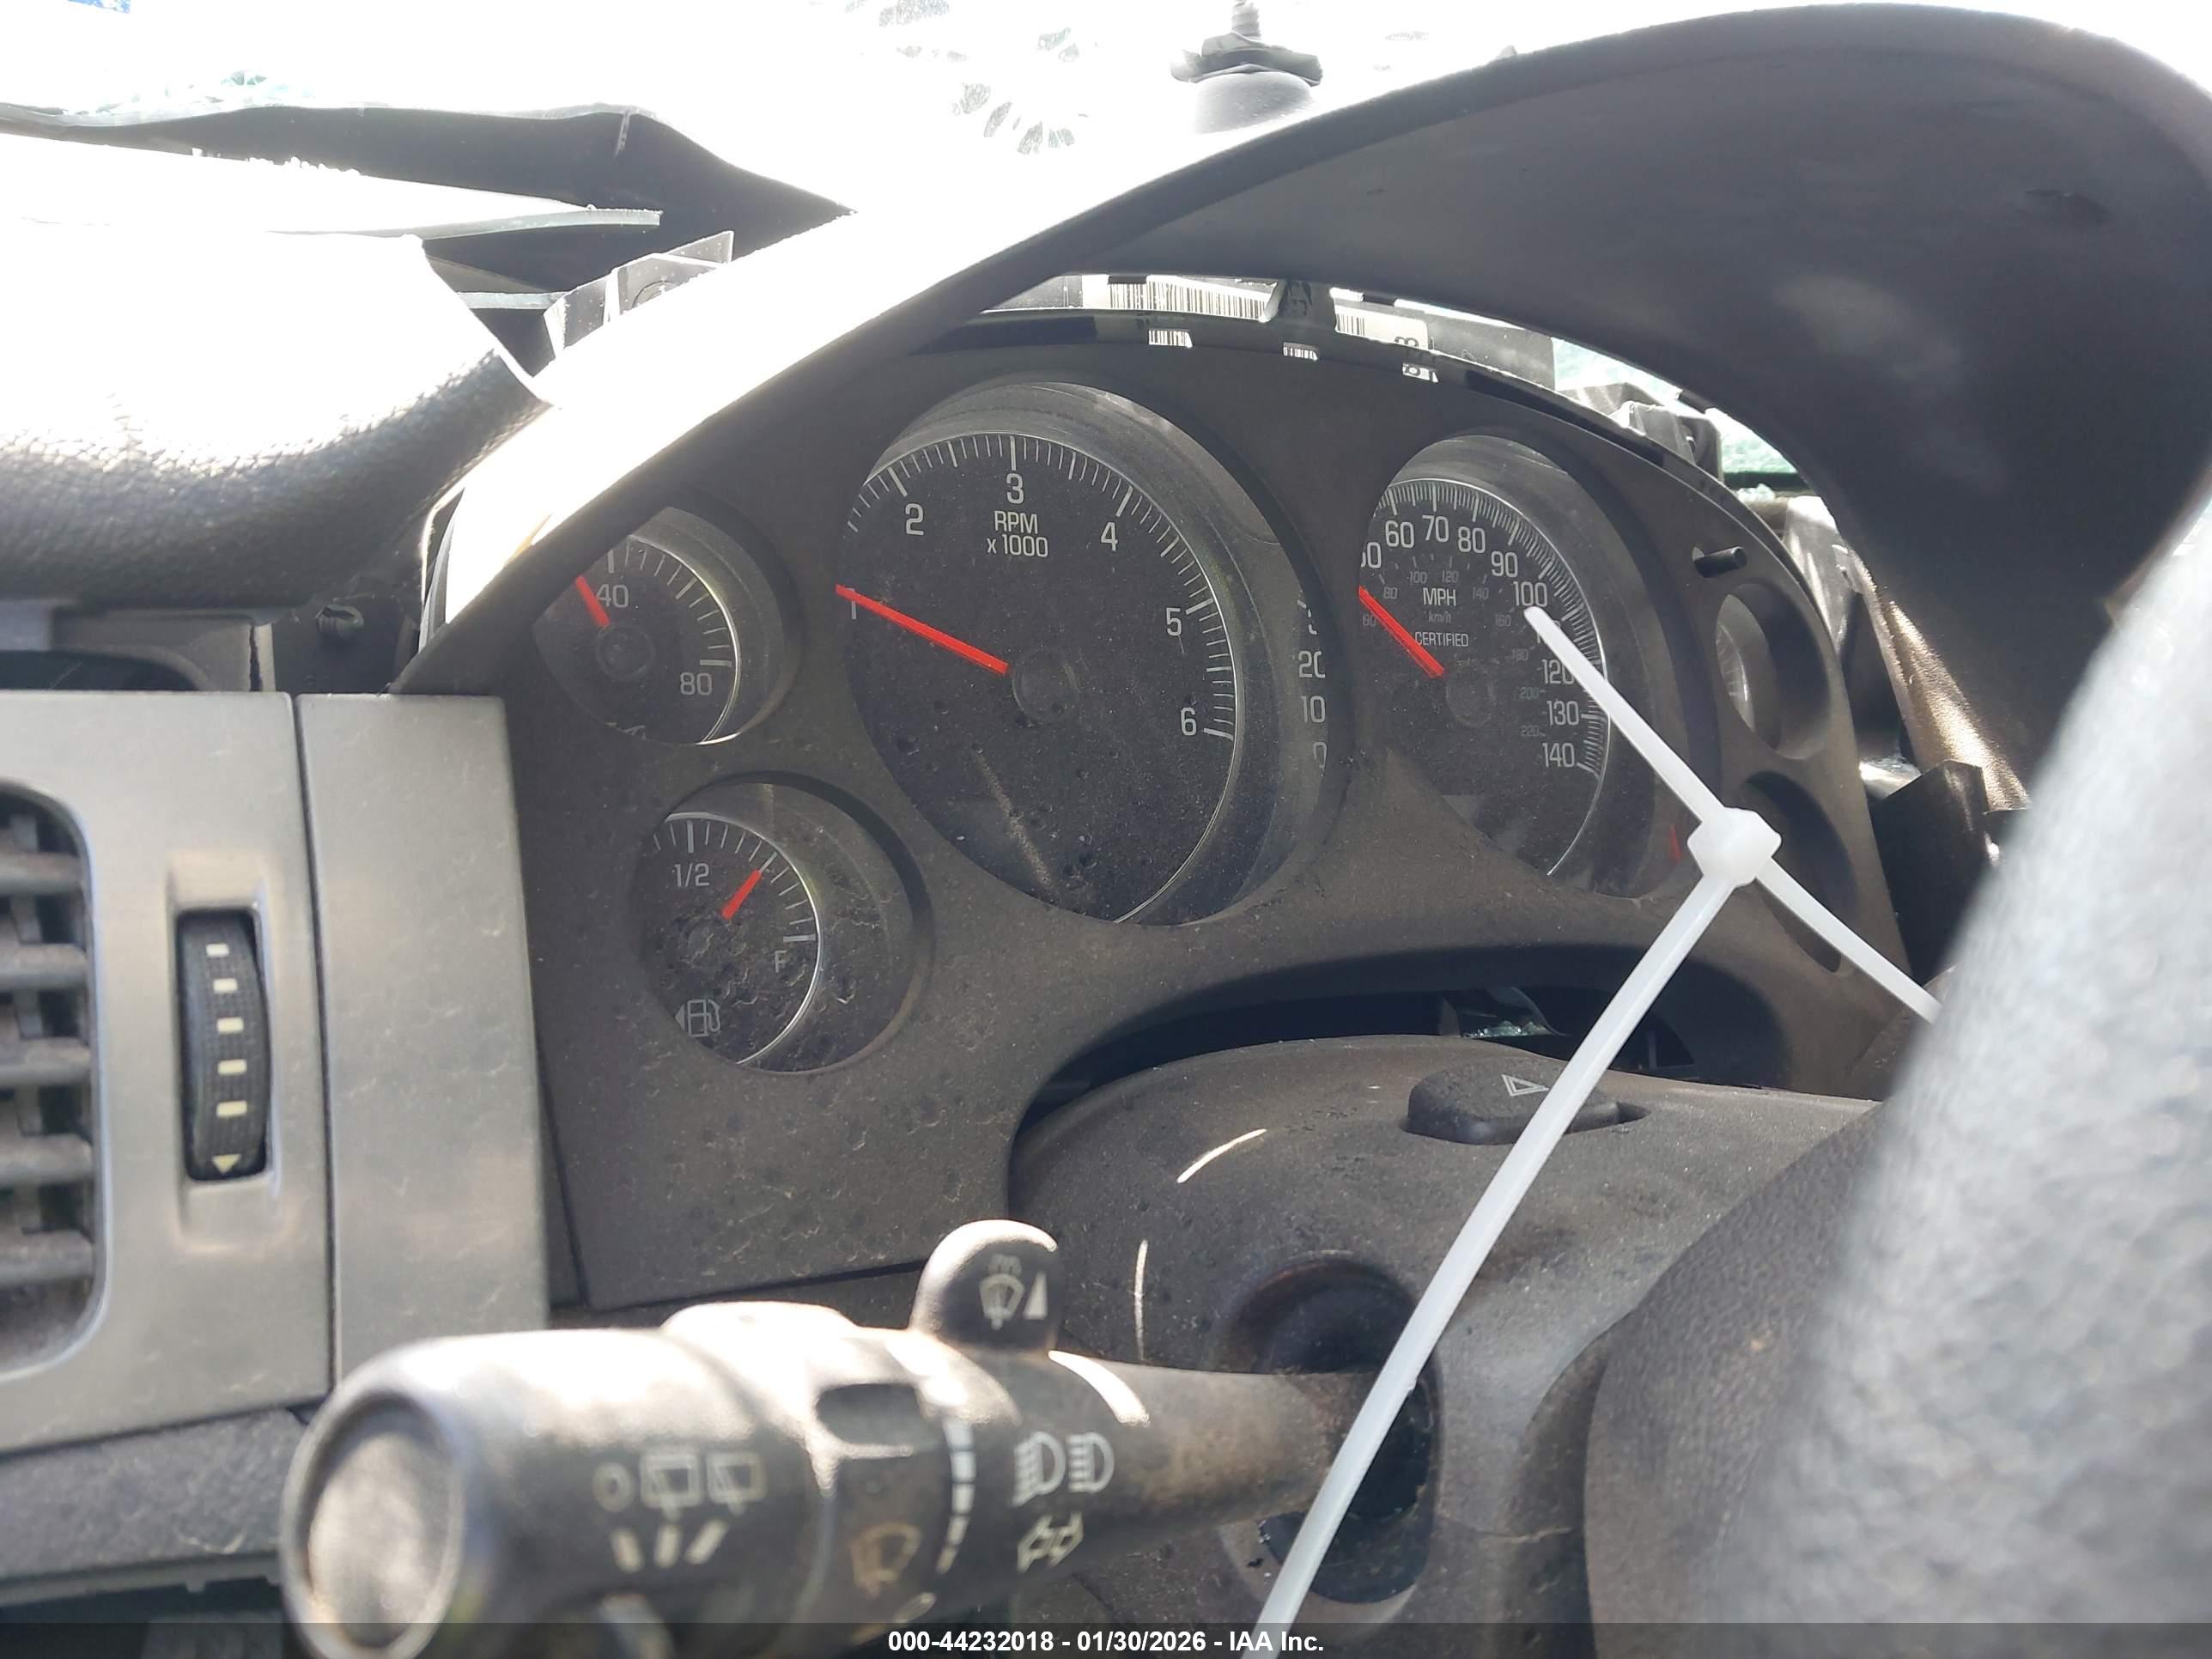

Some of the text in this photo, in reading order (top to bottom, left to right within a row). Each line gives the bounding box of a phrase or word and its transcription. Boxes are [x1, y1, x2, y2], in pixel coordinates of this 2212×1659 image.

[1006, 472, 1024, 504] 3
[904, 503, 924, 536] 2
[994, 510, 1038, 534] RPM
[1422, 515, 1449, 543] 70
[1002, 534, 1048, 557] 1000
[1100, 521, 1118, 551] 4
[1384, 520, 1415, 549] 60
[1457, 526, 1486, 554] 80
[1360, 542, 1382, 568] 0
[1491, 550, 1519, 578] 90
[596, 584, 629, 608] 40
[1423, 587, 1457, 606] MPH
[1512, 581, 1548, 607] 100
[1166, 607, 1182, 636] 5
[1415, 631, 1469, 647] CERTIFIED
[679, 672, 713, 696] 80
[1181, 707, 1197, 736] 6
[1301, 696, 1326, 723] 10
[1547, 700, 1580, 726] 130
[1542, 742, 1575, 769] 140
[674, 862, 710, 887] 1/2
[775, 950, 787, 973] F
